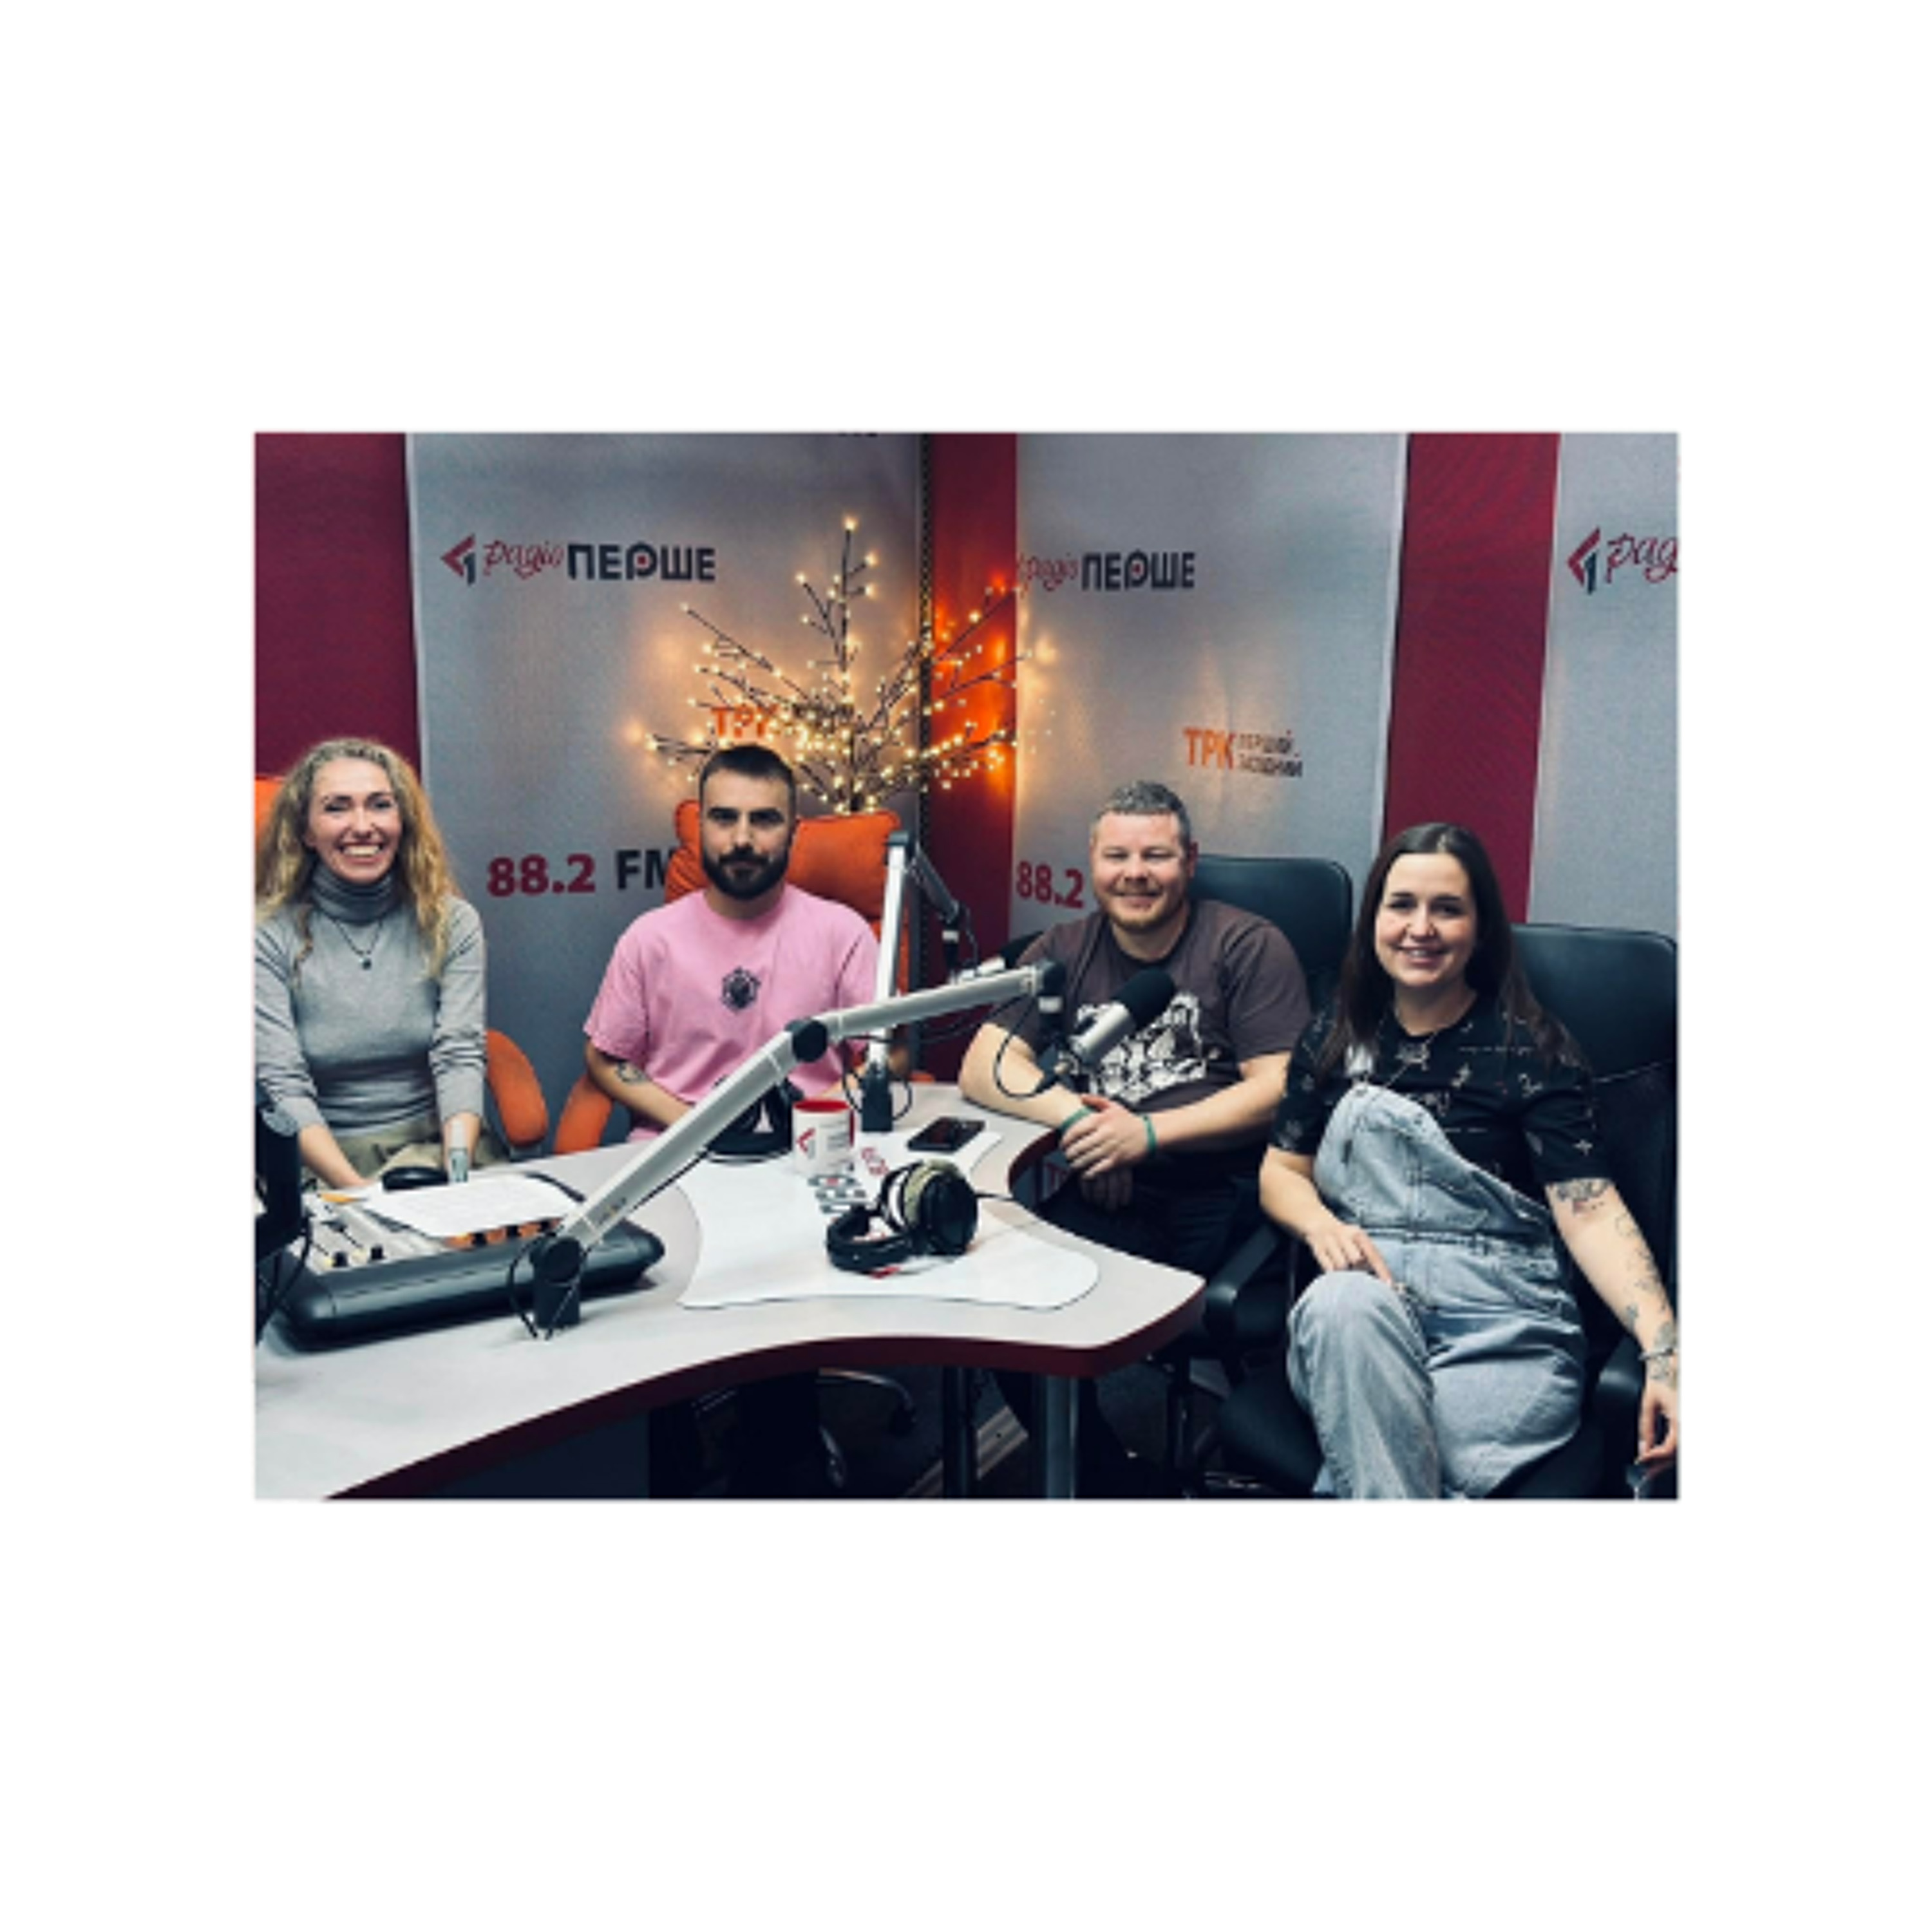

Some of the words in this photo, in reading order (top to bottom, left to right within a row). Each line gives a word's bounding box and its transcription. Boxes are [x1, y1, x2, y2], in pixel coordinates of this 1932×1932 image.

[567, 542, 715, 580] ПЕРШЕ
[1081, 549, 1195, 591] ПЕРШЕ
[1182, 727, 1235, 770] ТРК
[488, 853, 596, 897] 88.2
[1016, 860, 1083, 909] 88.2
